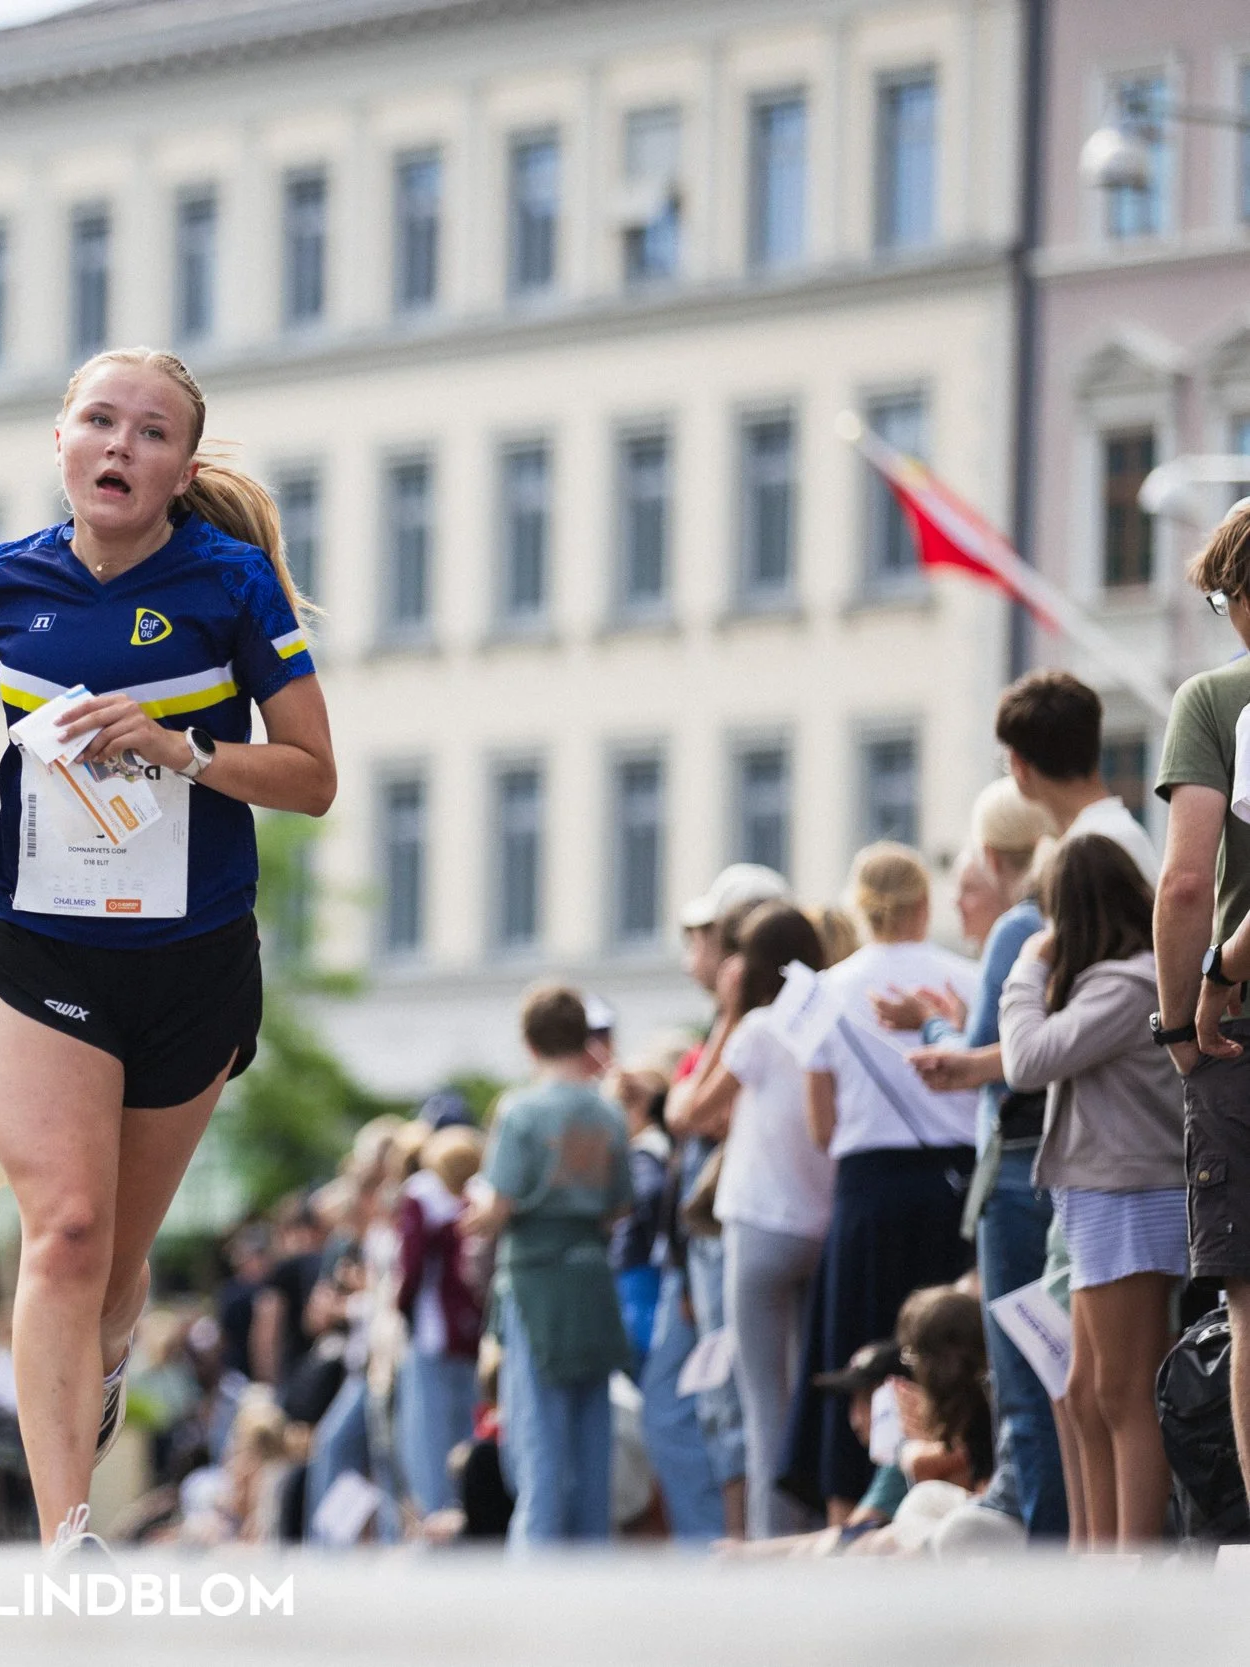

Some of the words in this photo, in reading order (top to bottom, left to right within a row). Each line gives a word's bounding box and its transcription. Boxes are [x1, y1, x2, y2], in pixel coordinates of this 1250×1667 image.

[139, 619, 160, 630] GIF
[140, 630, 153, 638] 06
[96, 859, 110, 867] ELIT
[53, 896, 96, 907] CHALMERS
